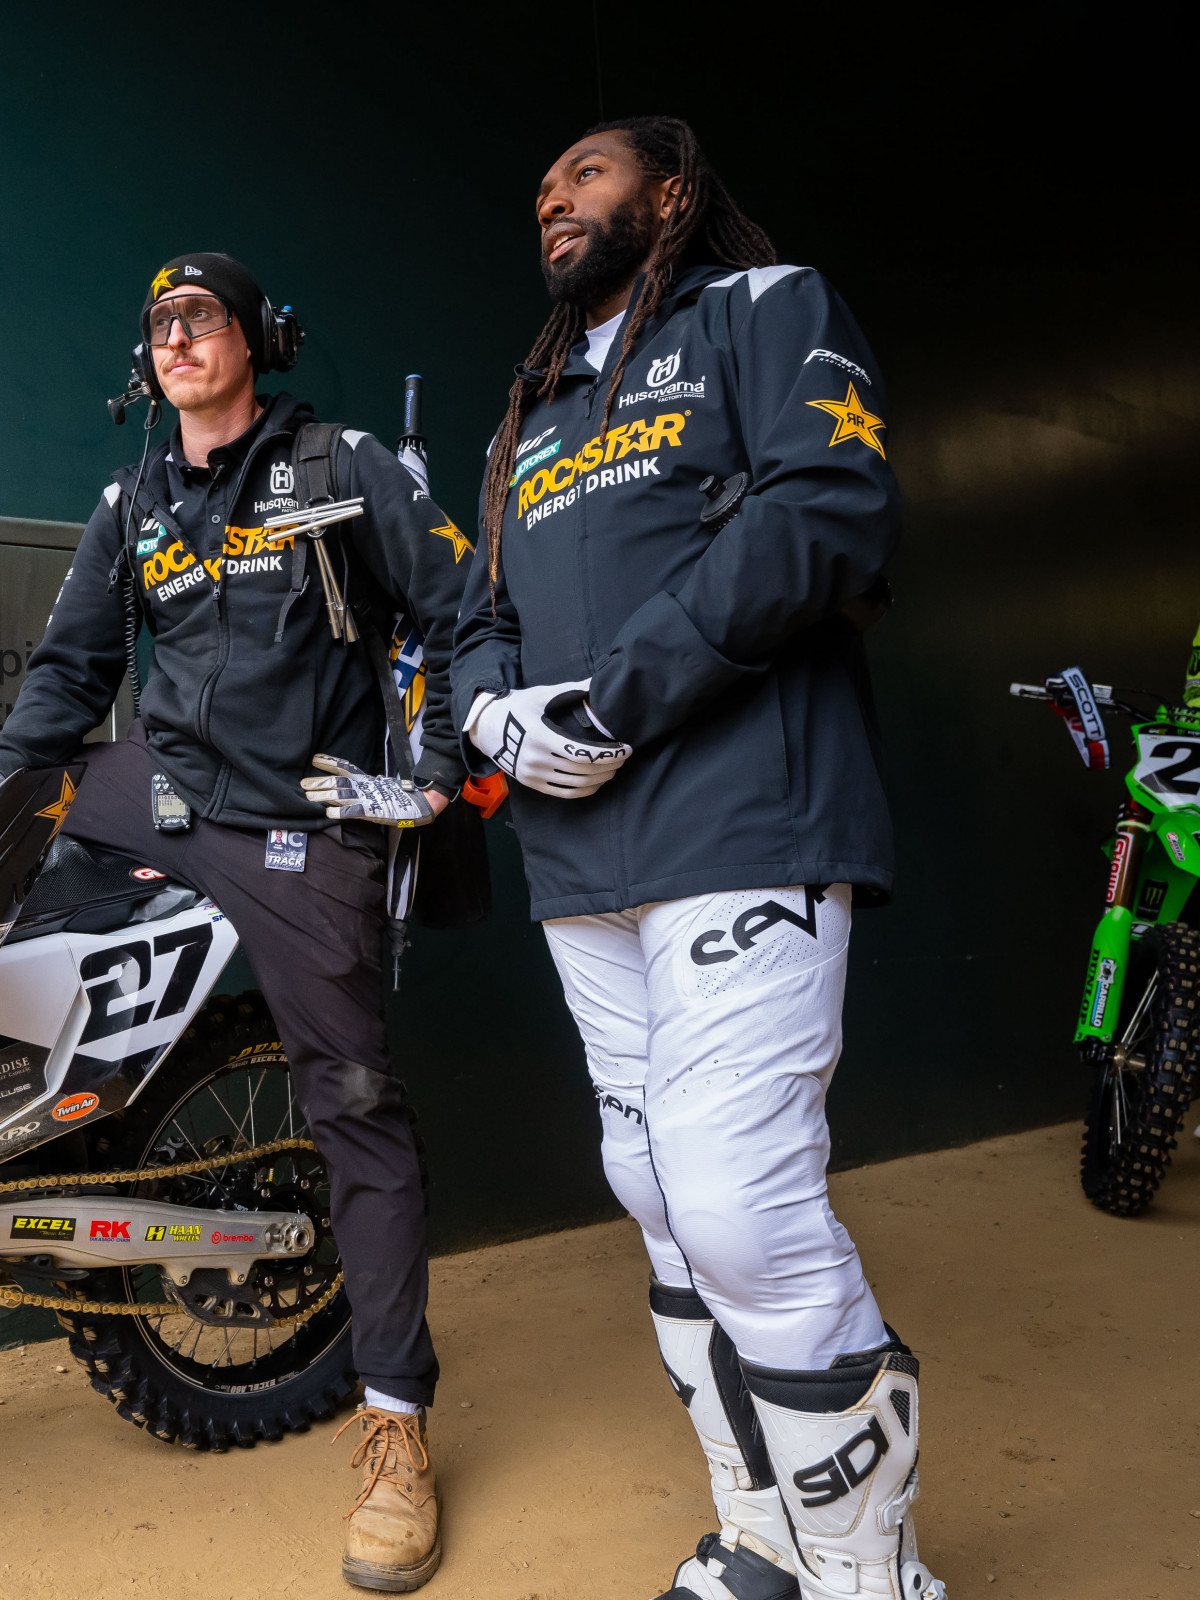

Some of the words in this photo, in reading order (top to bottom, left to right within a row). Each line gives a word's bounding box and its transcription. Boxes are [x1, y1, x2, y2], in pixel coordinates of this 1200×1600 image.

[619, 381, 705, 409] Husqvarna
[658, 394, 683, 403] FACTORY
[518, 412, 686, 519] ROCKSTAR
[526, 480, 583, 531] ENERGY
[585, 456, 661, 494] DRINK
[226, 555, 283, 575] DRINK
[1069, 674, 1102, 736] SCOTT
[564, 744, 626, 764] seven
[268, 855, 304, 867] TRACK
[77, 922, 214, 1047] 27
[56, 1103, 81, 1118] Twin
[81, 1096, 96, 1110] Air
[14, 1217, 75, 1231] EXCEL
[90, 1220, 132, 1239] RK
[168, 1225, 203, 1236] HAAN
[223, 1233, 254, 1242] brembo
[247, 1378, 276, 1392] EXCEL
